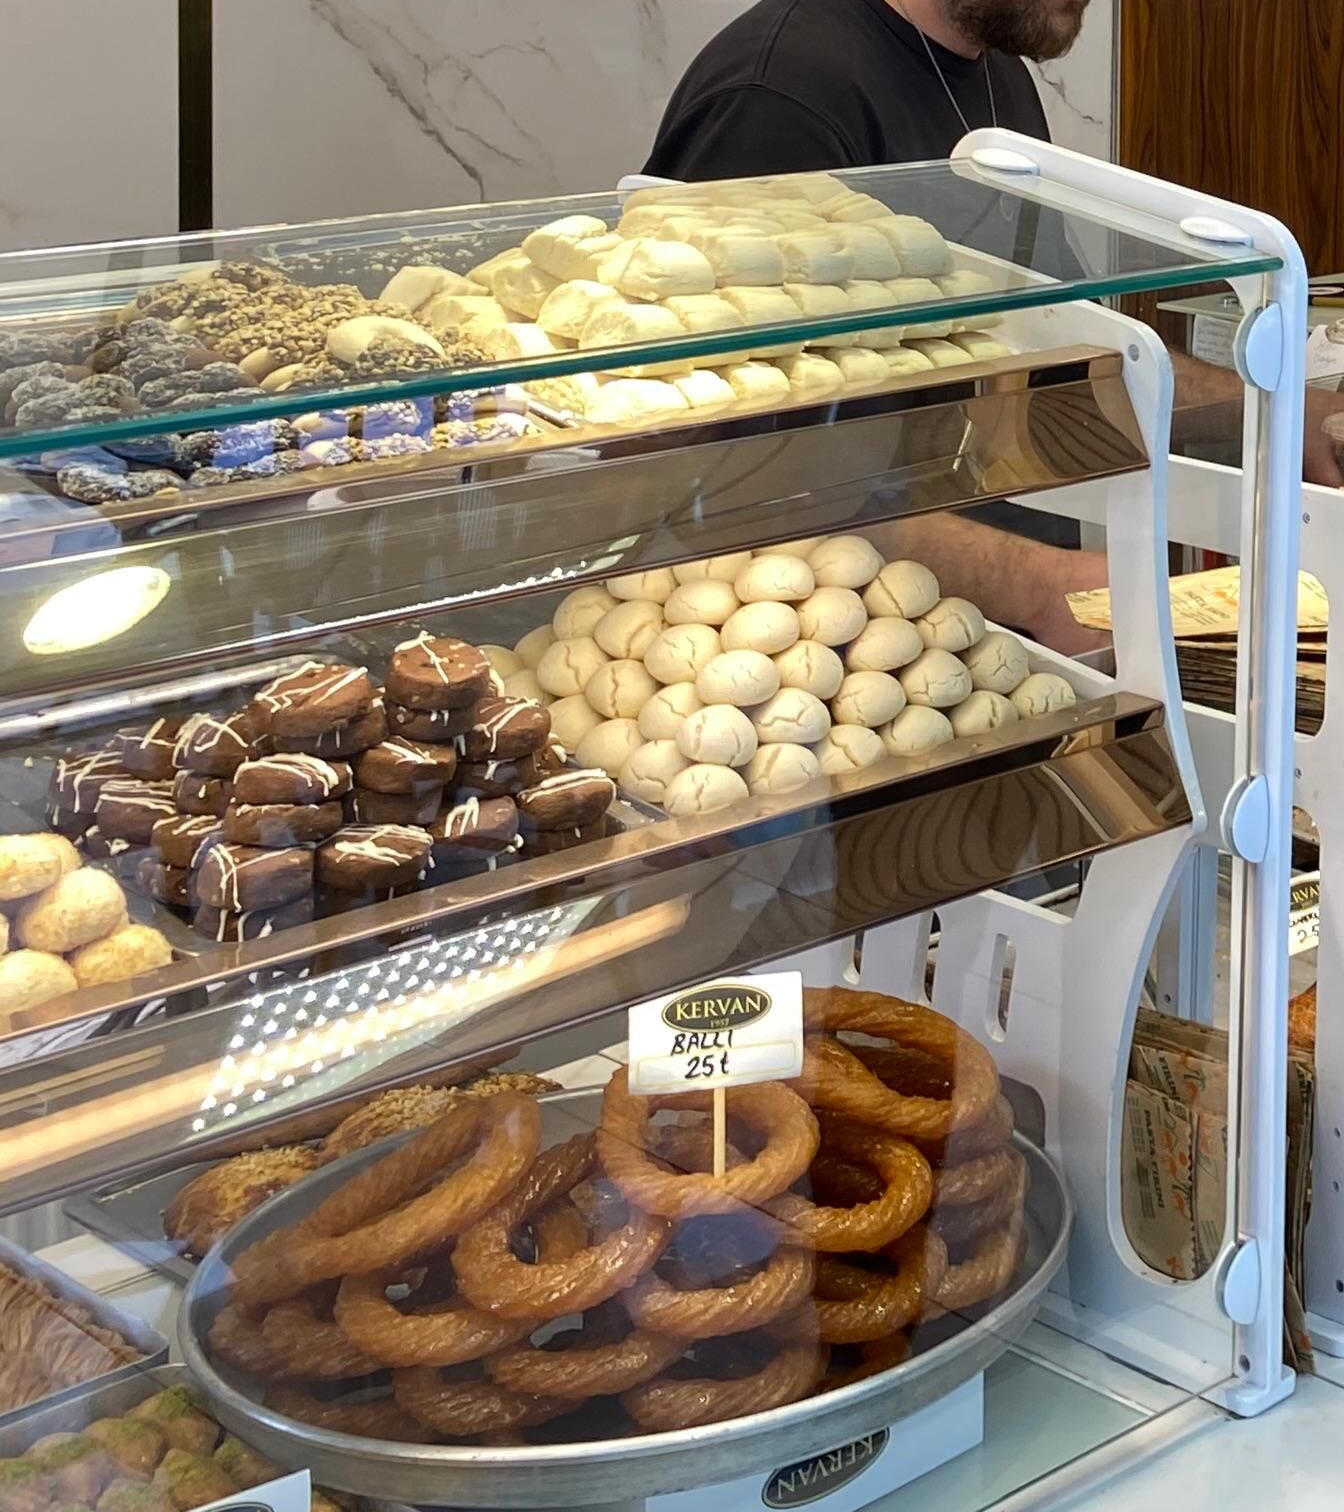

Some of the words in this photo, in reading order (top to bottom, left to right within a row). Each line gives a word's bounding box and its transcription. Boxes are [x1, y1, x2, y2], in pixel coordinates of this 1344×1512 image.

[676, 994, 762, 1021] KERVAN
[670, 1029, 733, 1057] BALLI
[777, 1434, 874, 1500] KERVAN
